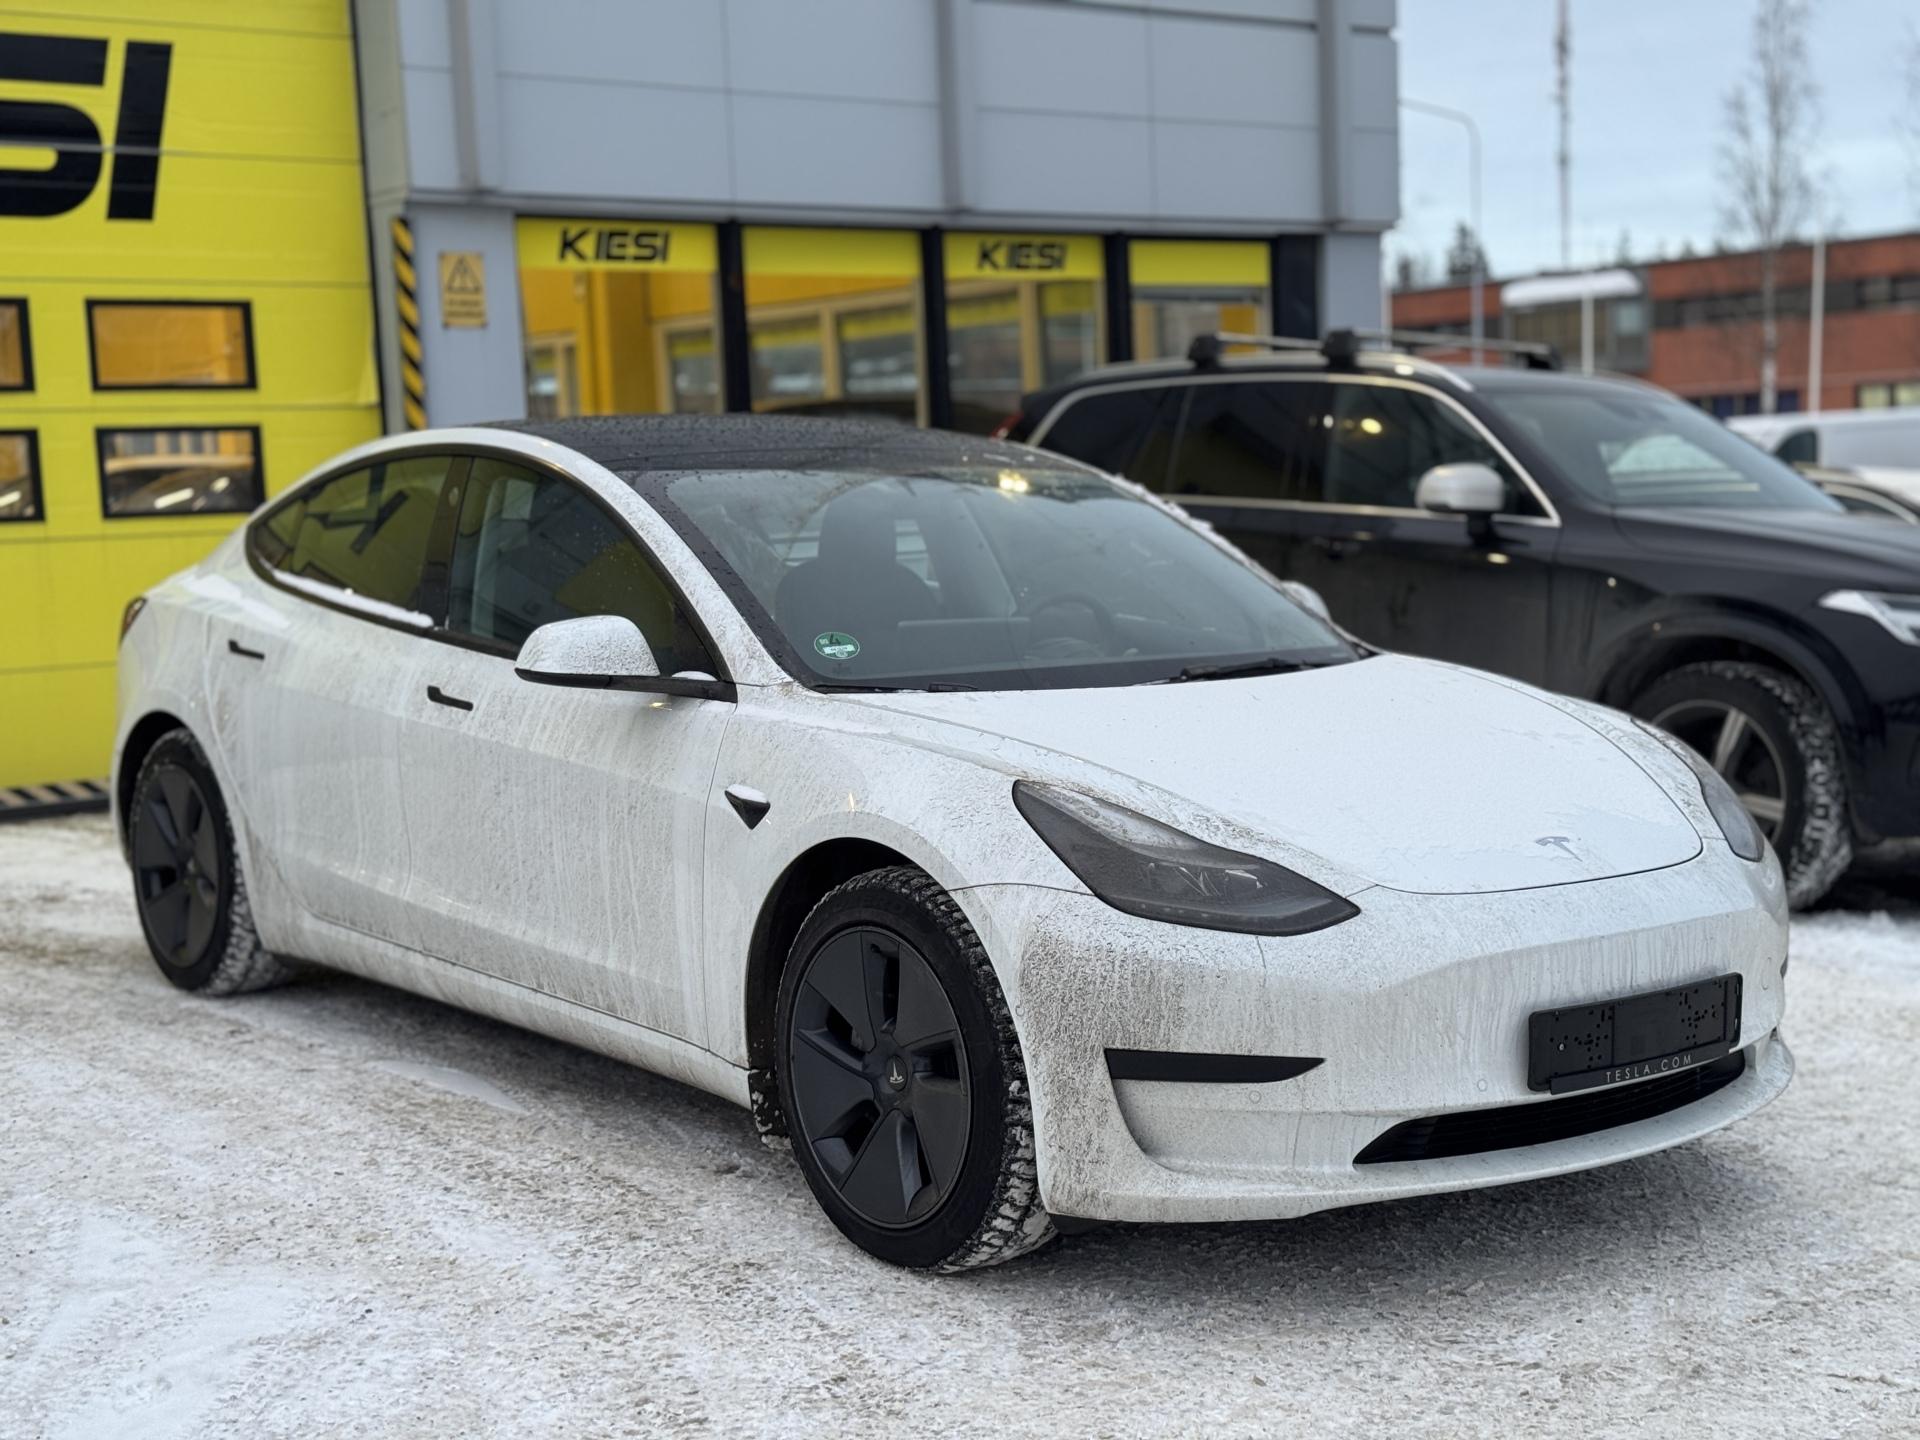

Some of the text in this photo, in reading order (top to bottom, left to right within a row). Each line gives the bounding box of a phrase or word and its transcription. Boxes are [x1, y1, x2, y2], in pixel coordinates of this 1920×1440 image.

[559, 228, 670, 261] KIESI
[977, 240, 1067, 270] KIESI
[1606, 1054, 1691, 1083] TESLA.COM
